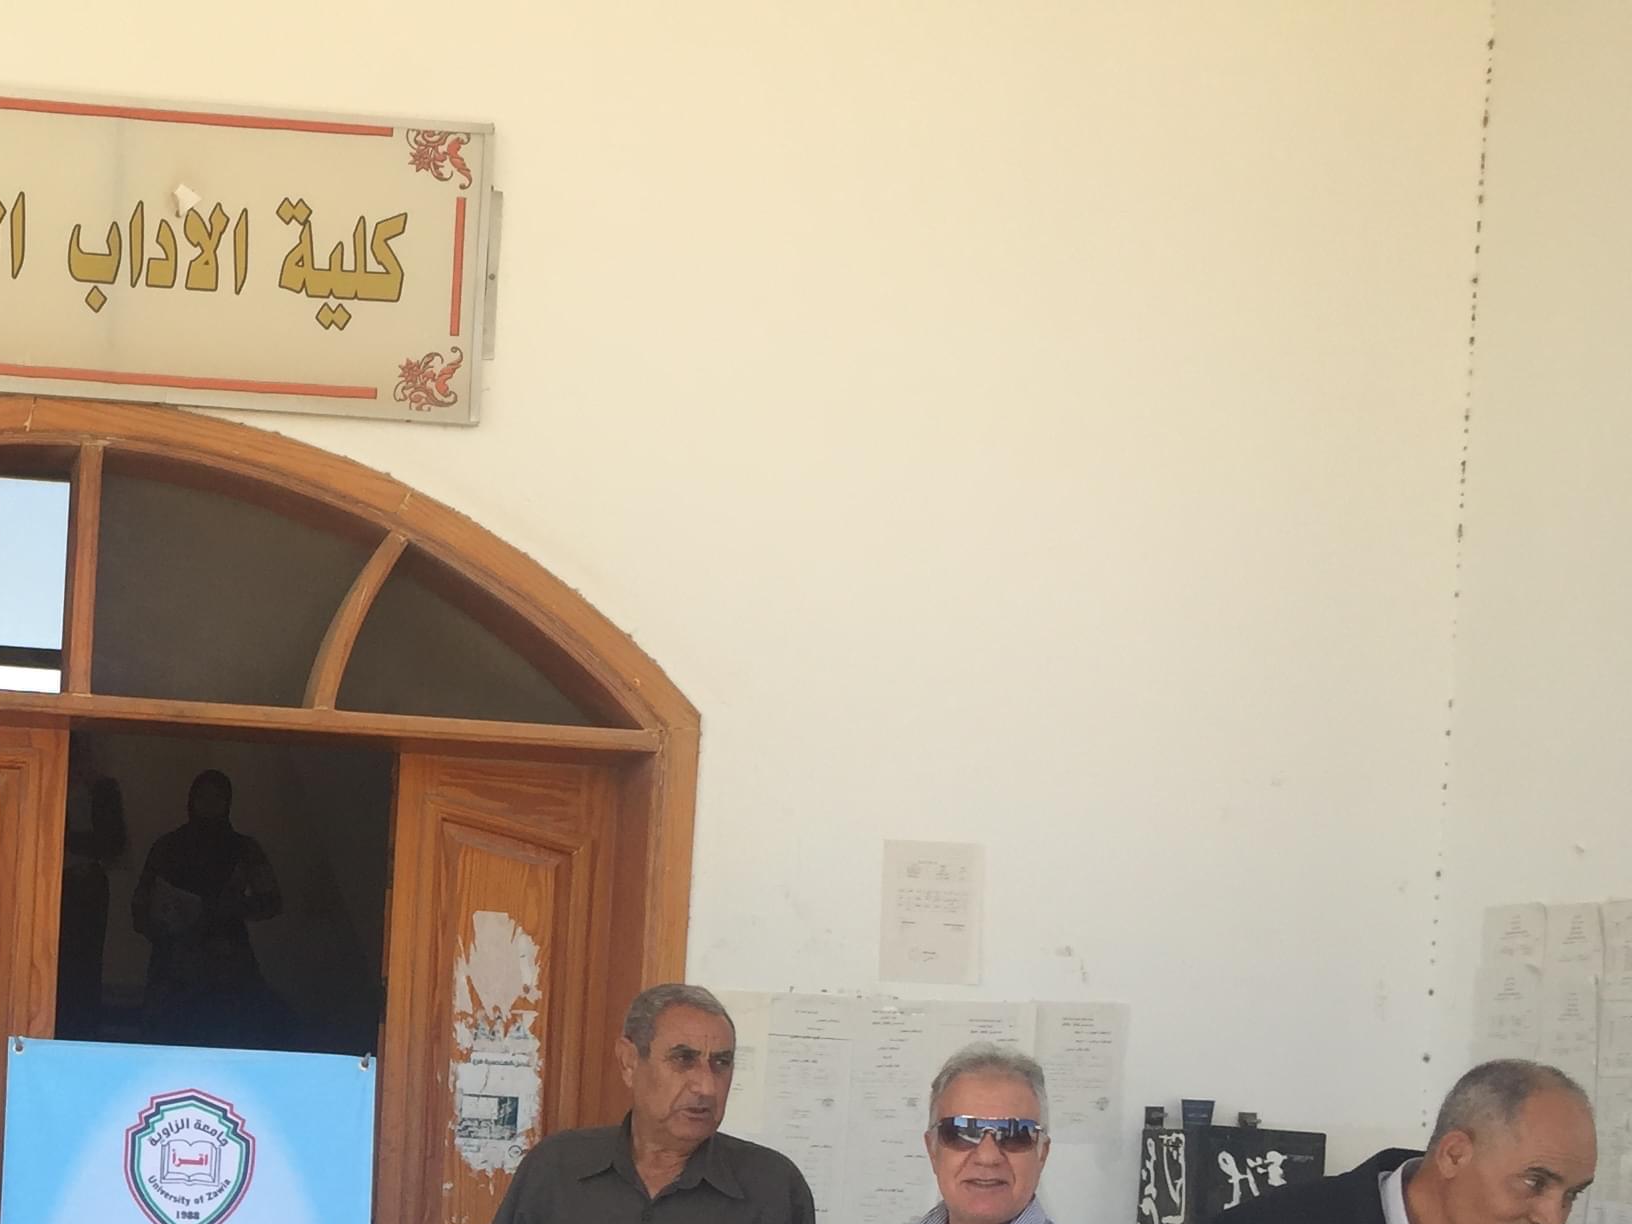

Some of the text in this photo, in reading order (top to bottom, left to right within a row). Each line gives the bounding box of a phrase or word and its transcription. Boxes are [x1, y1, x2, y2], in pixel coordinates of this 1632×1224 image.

[275, 196, 410, 332] كلية
[148, 1117, 230, 1147] جامعة الزاوية
[147, 1174, 232, 1206] University of Zawia
